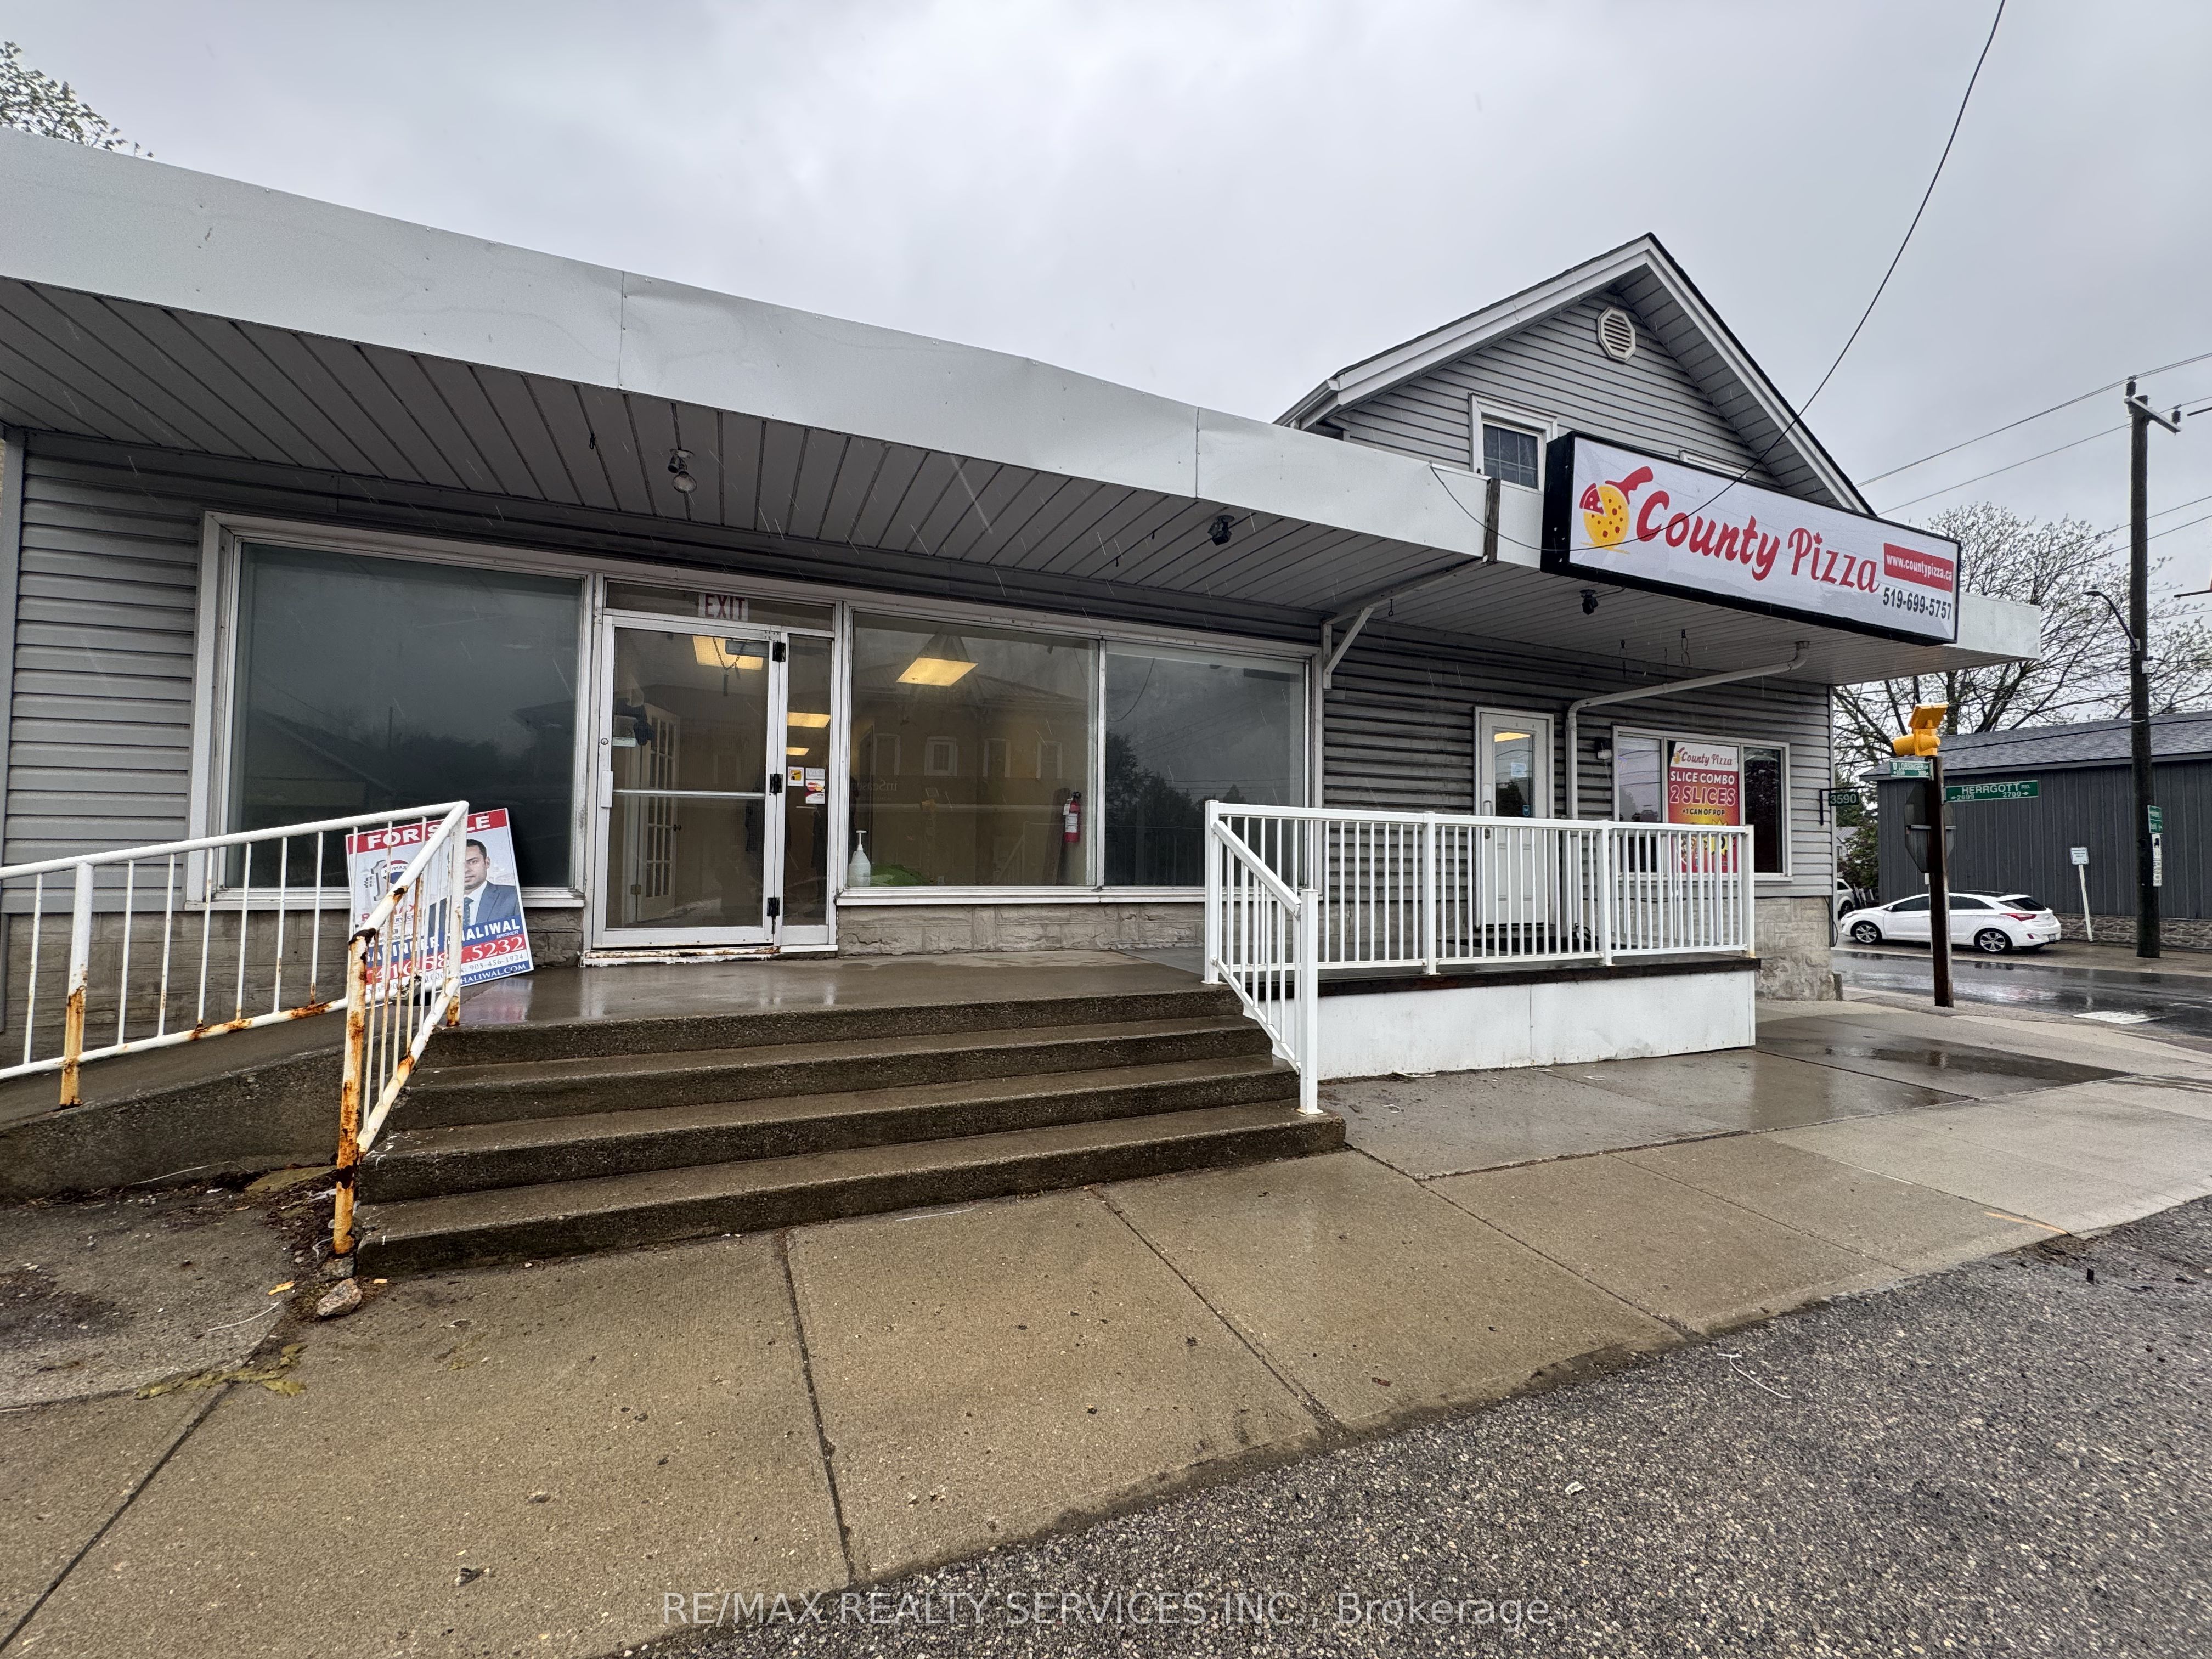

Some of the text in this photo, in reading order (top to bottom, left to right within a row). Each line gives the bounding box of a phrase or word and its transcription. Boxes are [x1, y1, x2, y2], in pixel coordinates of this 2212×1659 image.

[1636, 490, 1880, 593] County Pizza
[1886, 555, 1953, 582] www.countypizza.ca
[704, 593, 746, 620] EXIT
[1883, 587, 1952, 620] 519-699-5757
[1681, 752, 1733, 766] County Pizza
[1671, 771, 1735, 785] SLICE COMBO
[1669, 785, 1736, 806] 2 SLICES
[1830, 794, 1857, 804] 3590
[1961, 783, 2021, 795] HERRGOTT
[367, 828, 420, 849] FOR
[496, 930, 519, 939] BROKER
